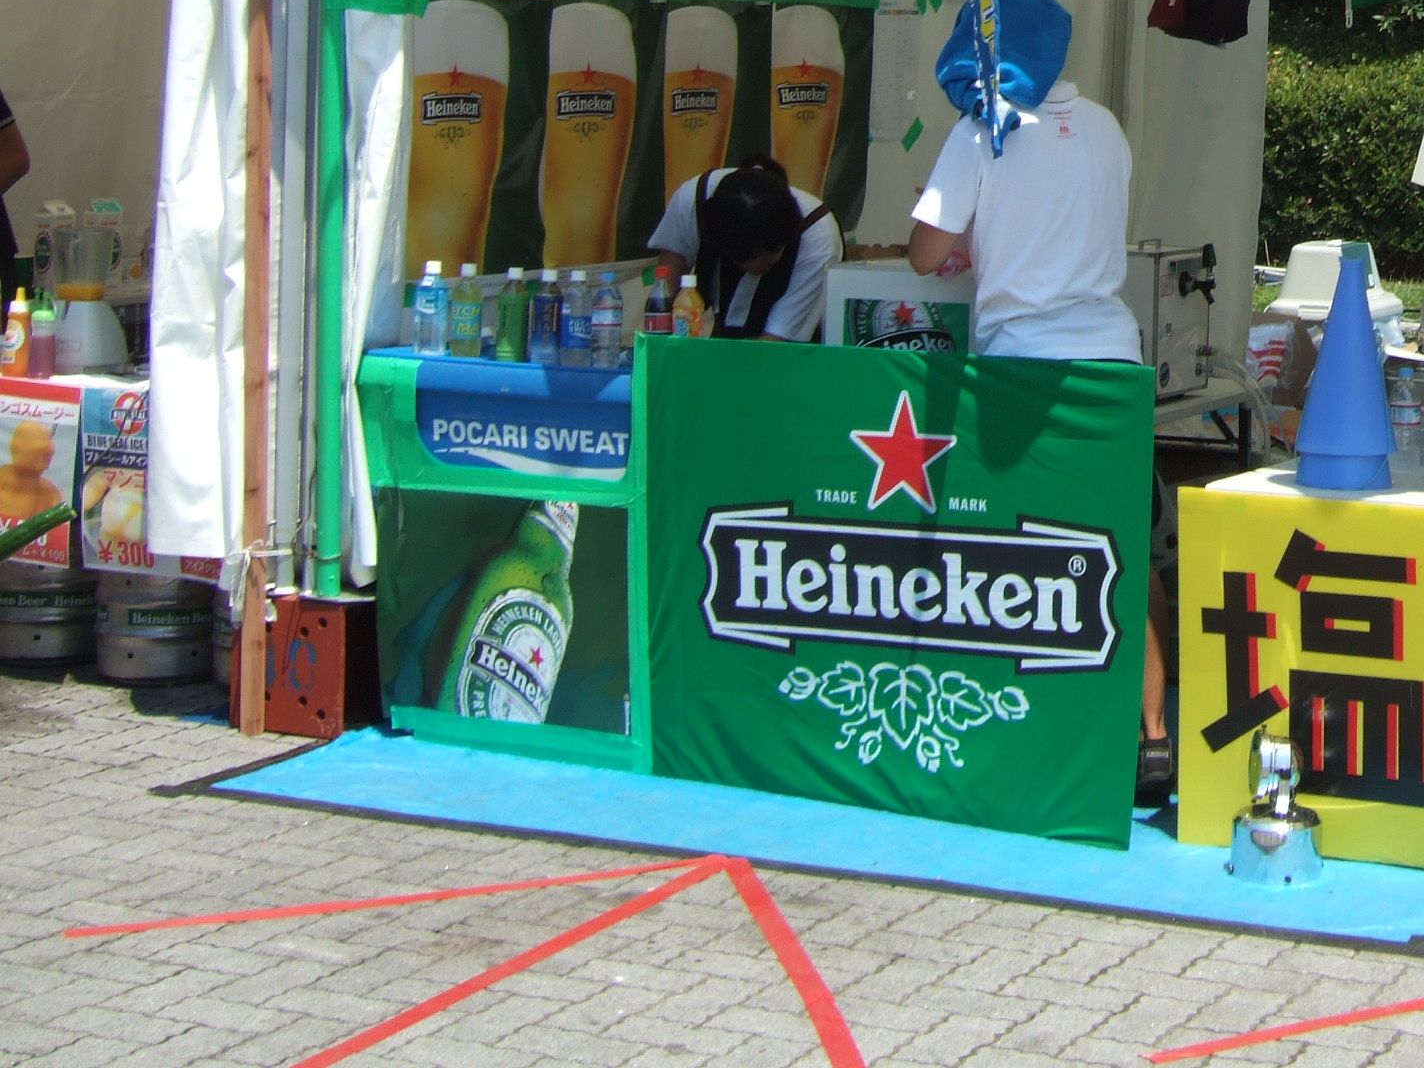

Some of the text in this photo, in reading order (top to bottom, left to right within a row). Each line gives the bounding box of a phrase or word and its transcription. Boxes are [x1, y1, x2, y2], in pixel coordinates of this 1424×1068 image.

[673, 91, 717, 111] Heineken
[780, 86, 828, 104] Heineken
[425, 98, 481, 119] Heineken
[558, 95, 615, 116] Heineken
[432, 418, 630, 457] POCARI SWEAT
[815, 488, 858, 505] TRADE
[948, 496, 988, 513] MARK
[492, 601, 544, 635] HEINEKEN
